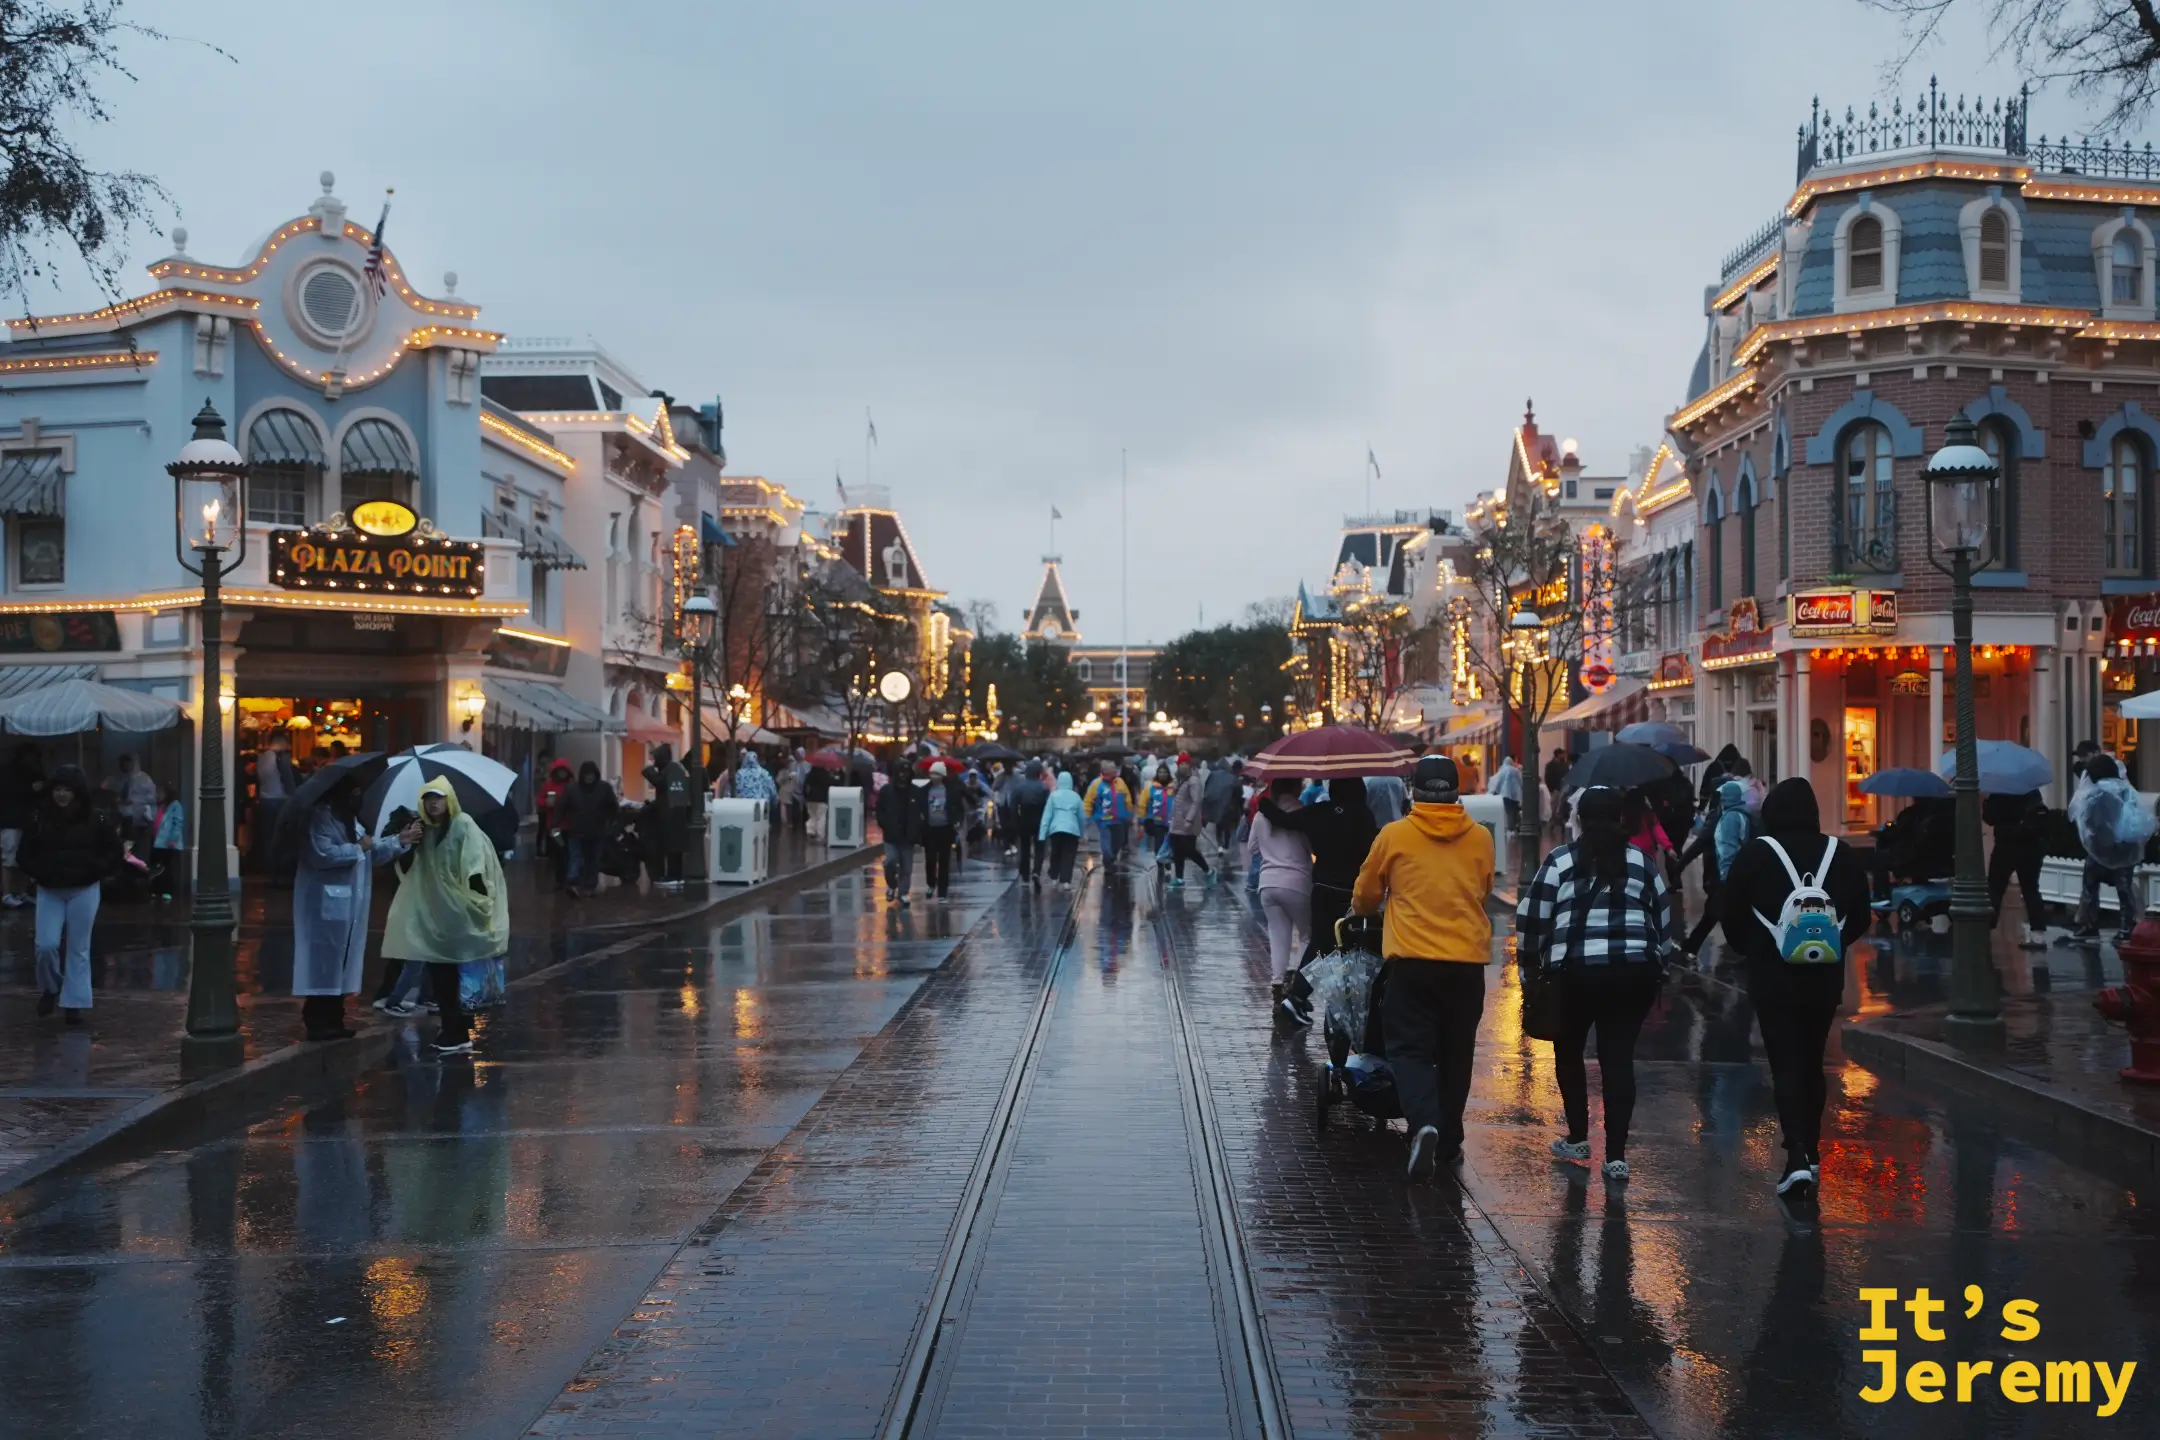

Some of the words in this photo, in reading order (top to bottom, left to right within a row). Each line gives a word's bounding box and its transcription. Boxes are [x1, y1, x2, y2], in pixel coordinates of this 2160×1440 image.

[291, 543, 383, 574] PLAZA
[388, 548, 472, 578] POINT
[354, 621, 396, 632] SHOPPE
